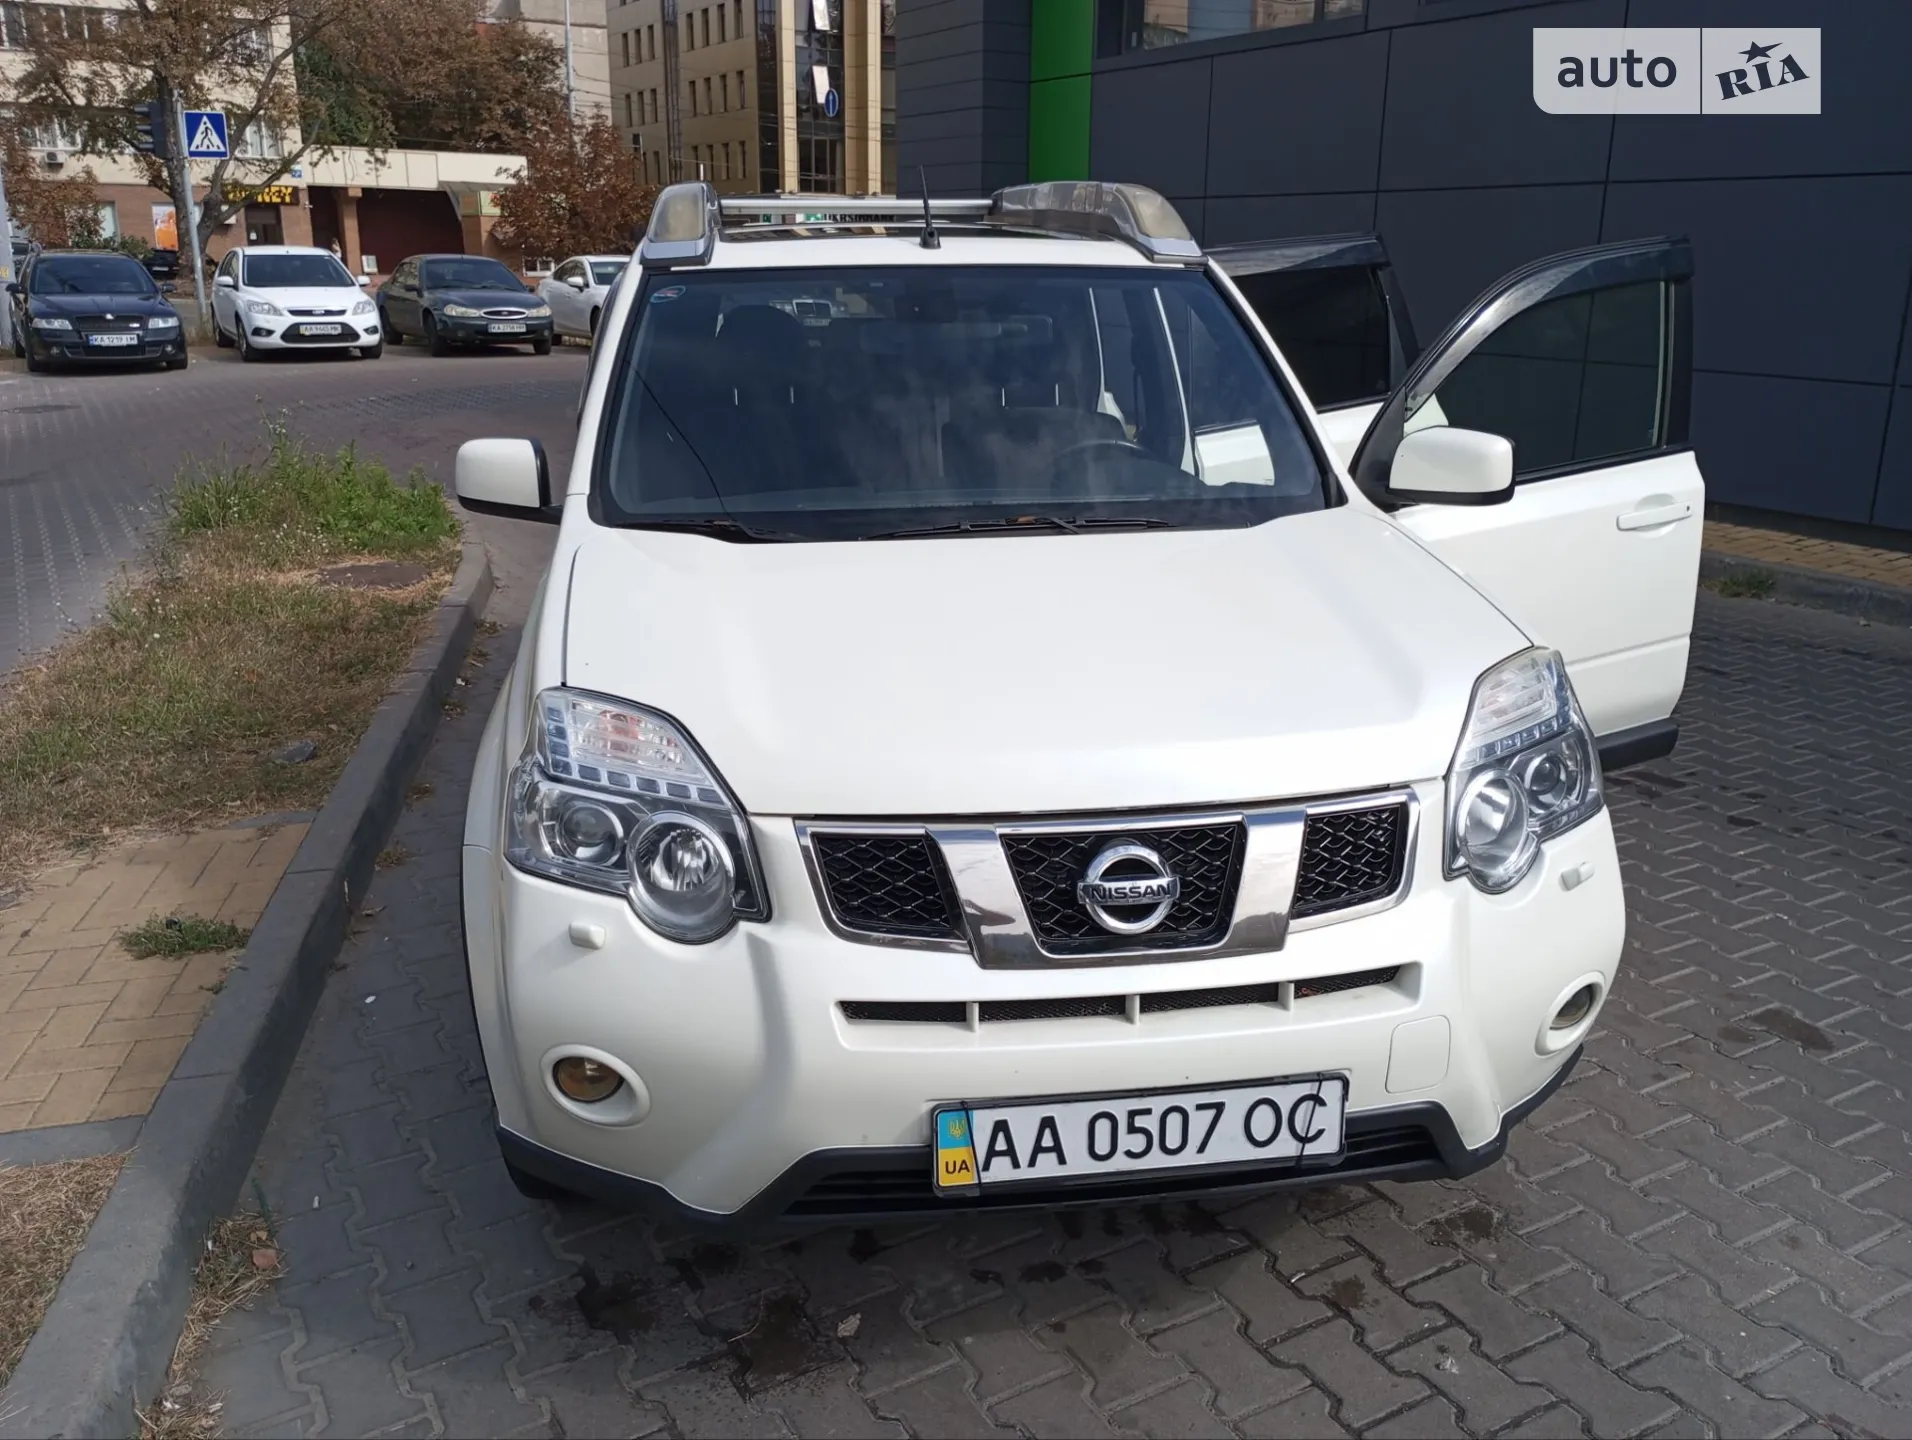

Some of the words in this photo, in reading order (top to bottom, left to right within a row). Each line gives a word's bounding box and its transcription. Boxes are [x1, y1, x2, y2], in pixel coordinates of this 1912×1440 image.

[1091, 883, 1171, 900] NISSAN
[981, 1114, 1067, 1172] AA
[1087, 1101, 1226, 1162] 0507
[1243, 1092, 1328, 1149] OC
[945, 1160, 971, 1175] UA
